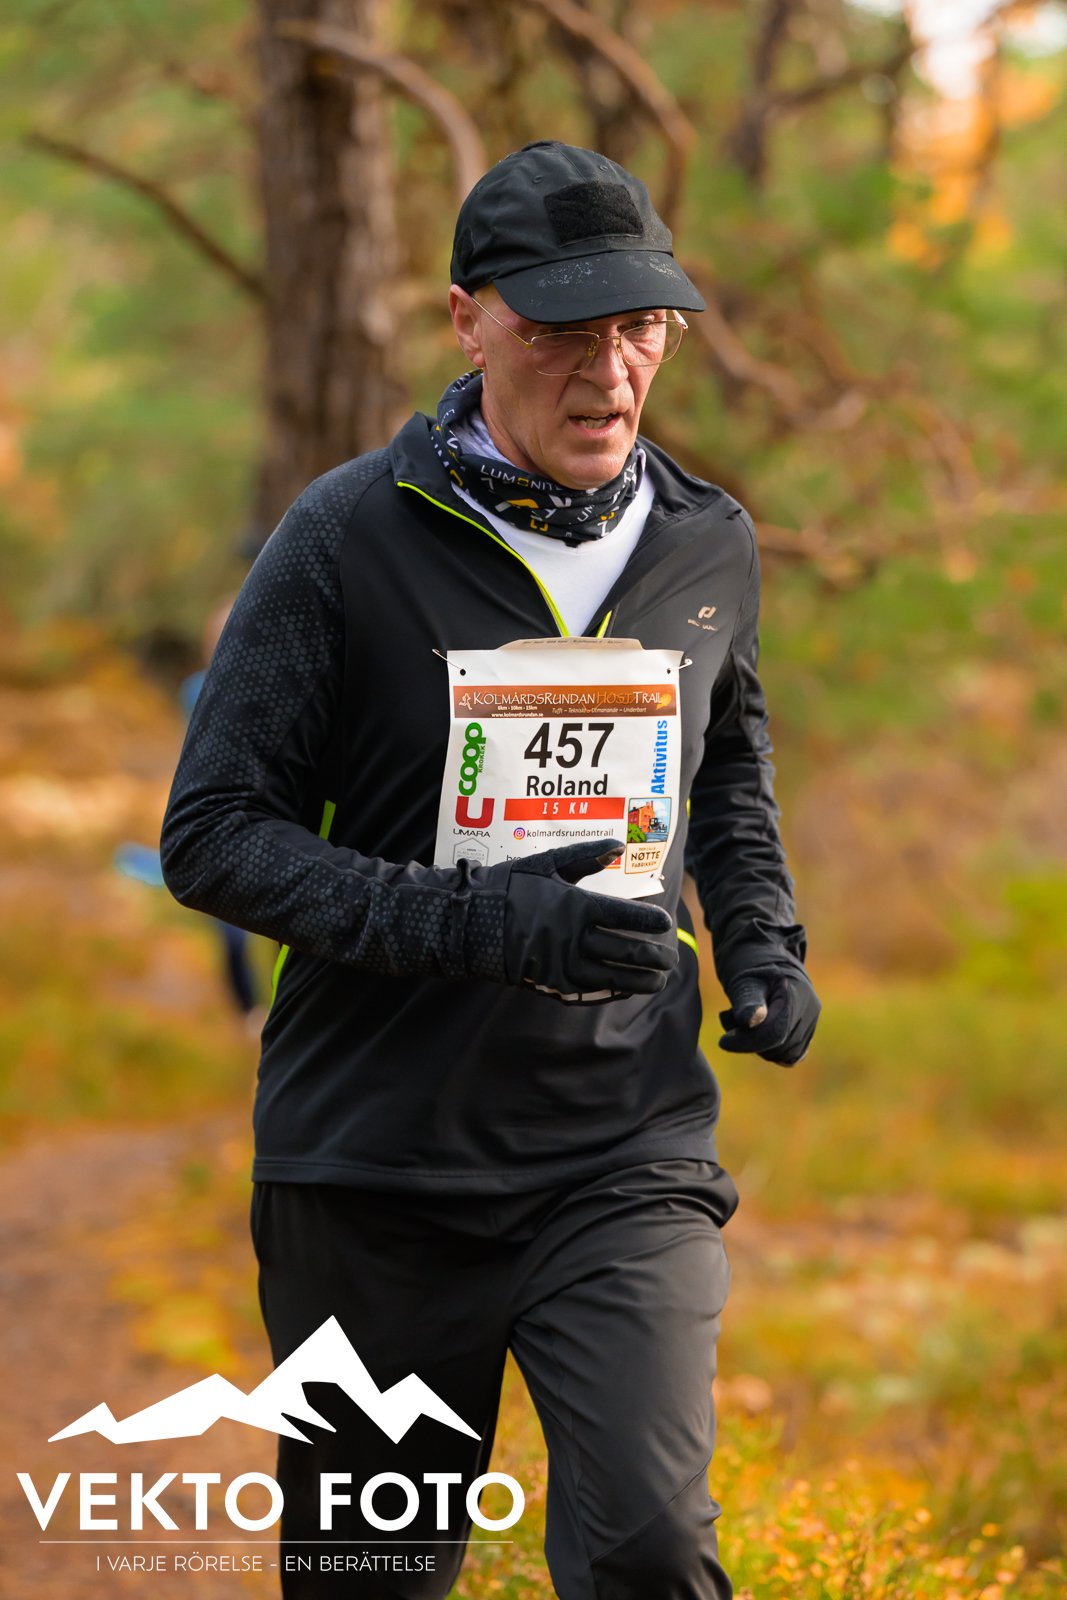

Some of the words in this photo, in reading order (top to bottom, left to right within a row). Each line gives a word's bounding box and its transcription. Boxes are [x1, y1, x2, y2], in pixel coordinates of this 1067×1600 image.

[523, 722, 616, 769] 457
[458, 722, 486, 796] coop
[650, 720, 668, 795] Aktivitus
[526, 774, 609, 796] Roland
[541, 802, 559, 815] 15
[568, 802, 589, 814] KM
[453, 828, 491, 838] UMARA
[526, 828, 614, 838] kolmardsrundantrail
[631, 851, 661, 862] NØTTE
